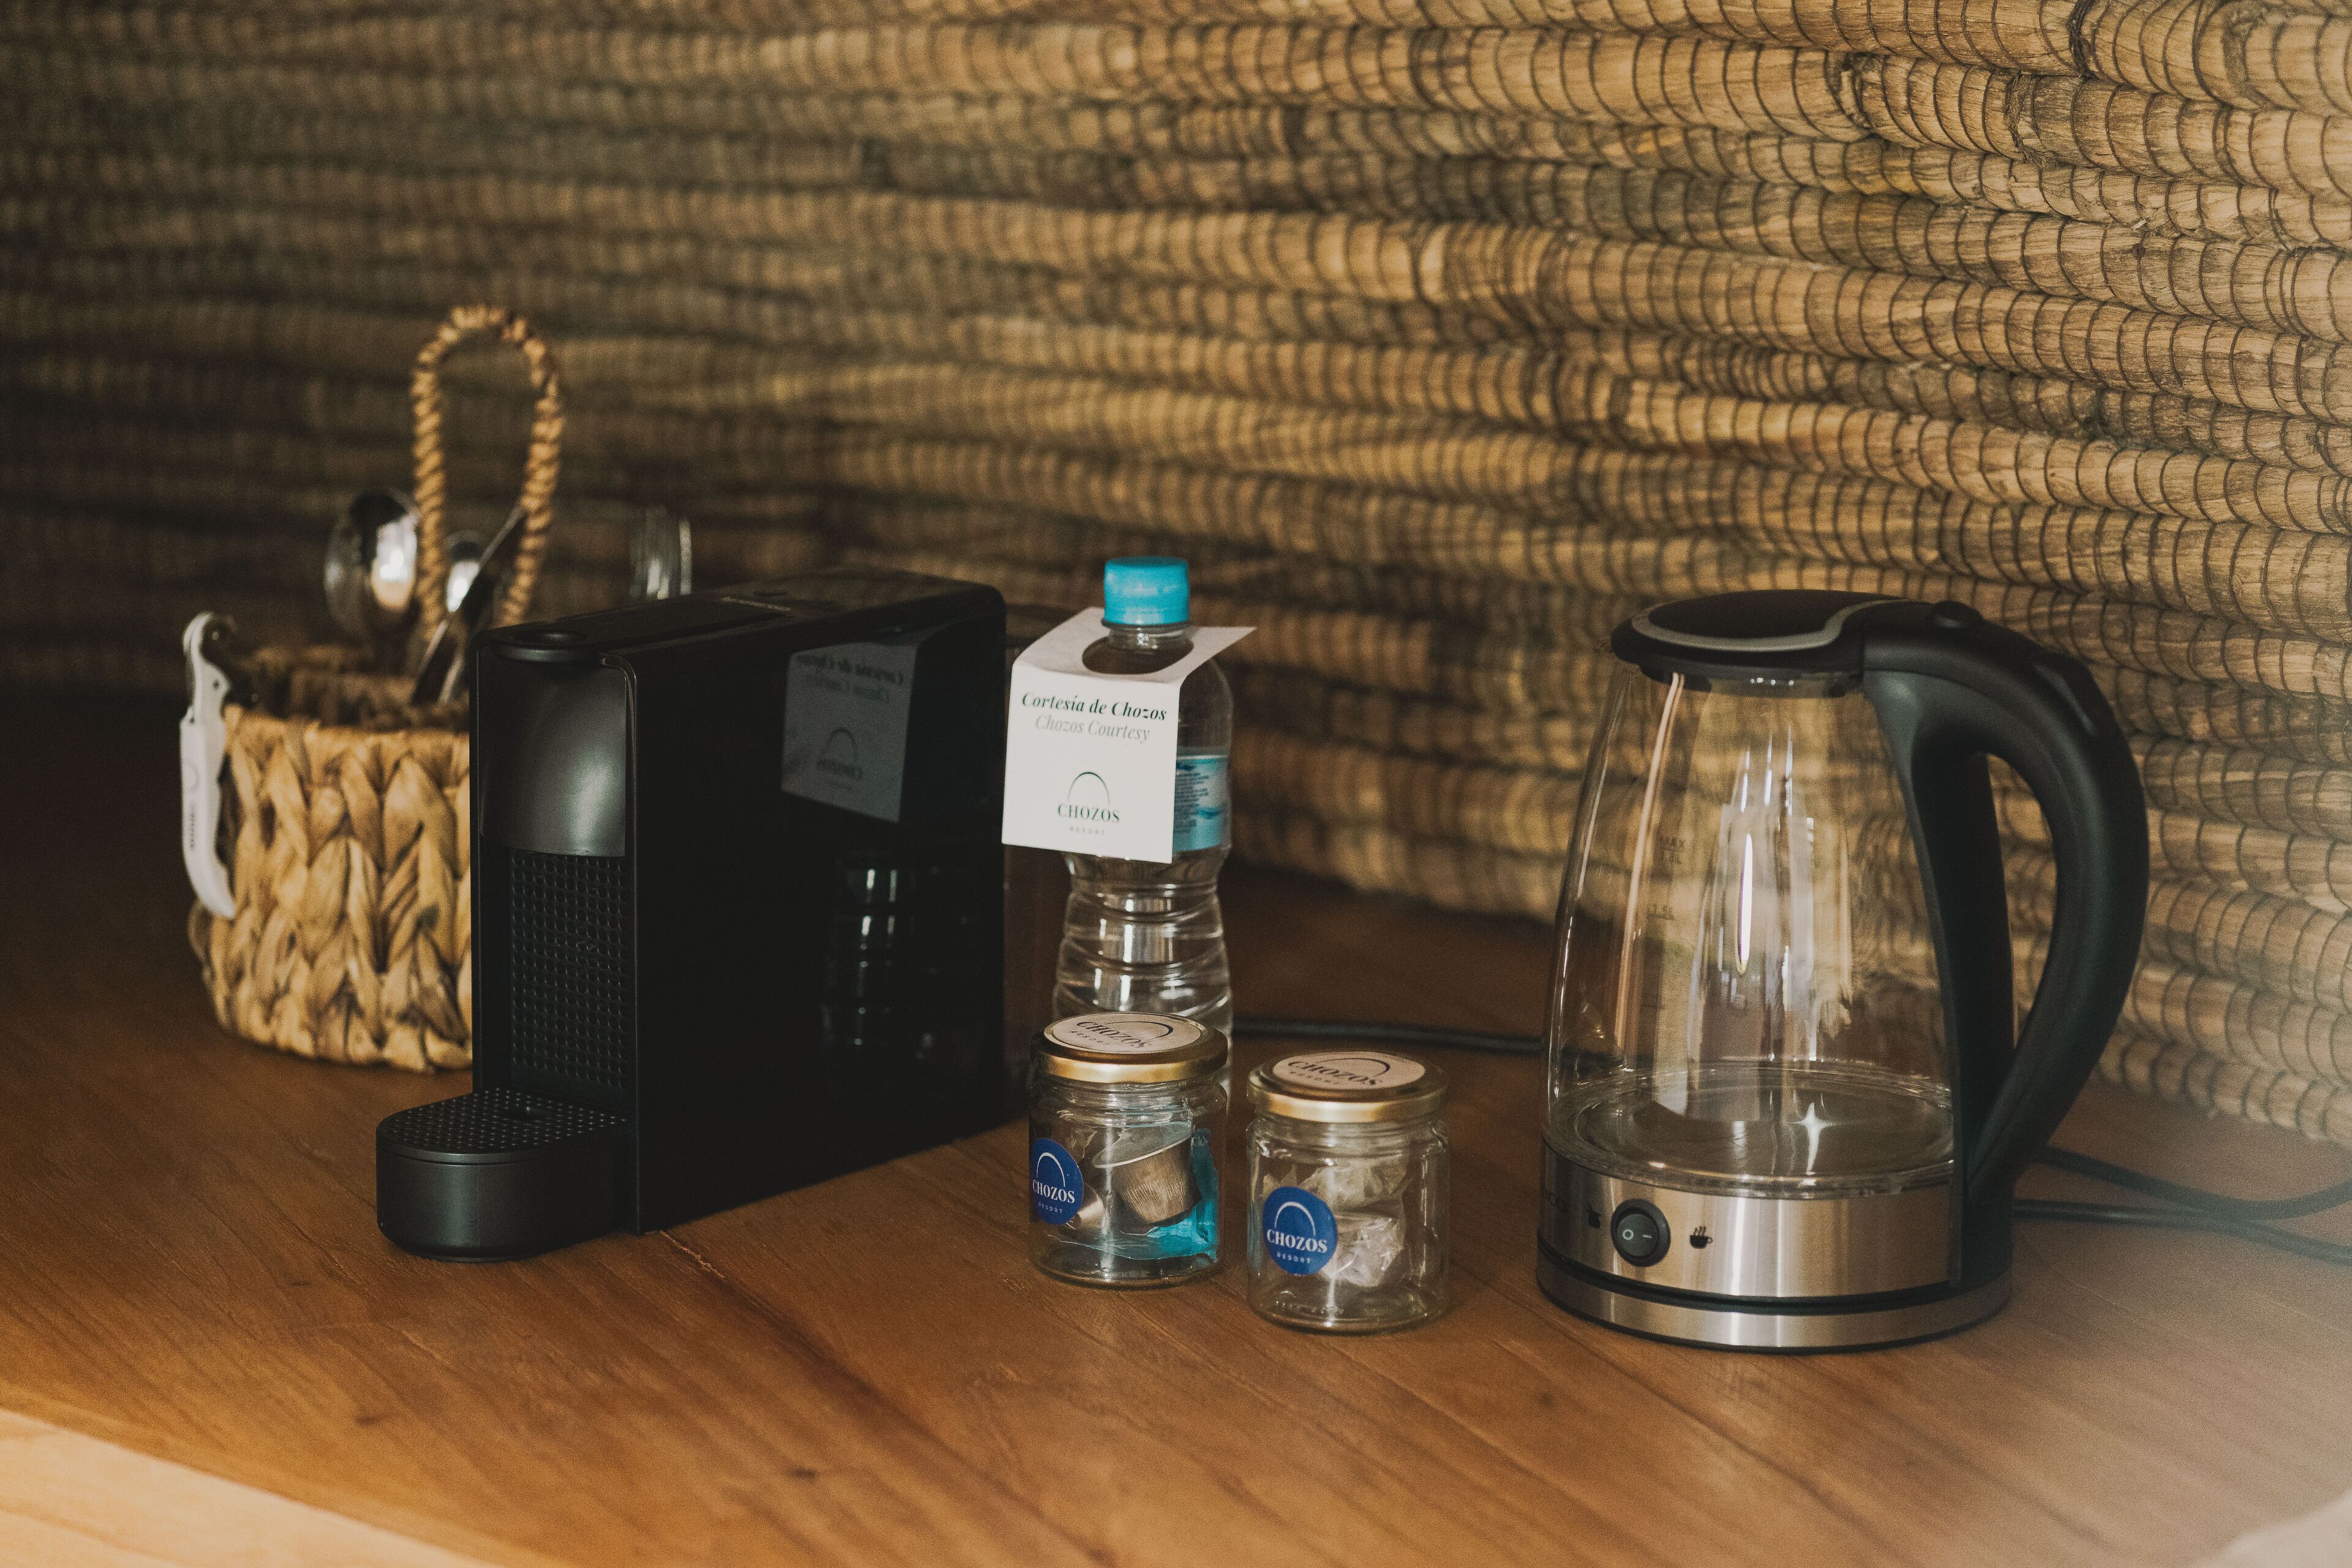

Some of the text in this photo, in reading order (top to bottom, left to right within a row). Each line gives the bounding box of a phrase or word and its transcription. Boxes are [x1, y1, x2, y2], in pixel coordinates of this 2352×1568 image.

[1022, 692, 1167, 721] Cortesía de Chozos
[1035, 714, 1151, 744] Chozos Courtesy
[1057, 804, 1120, 823] CHOZOS
[1076, 1022, 1152, 1048] CHOZOS
[1032, 1179, 1075, 1204] CHOZOS
[1267, 1229, 1328, 1253] CHOZOS
